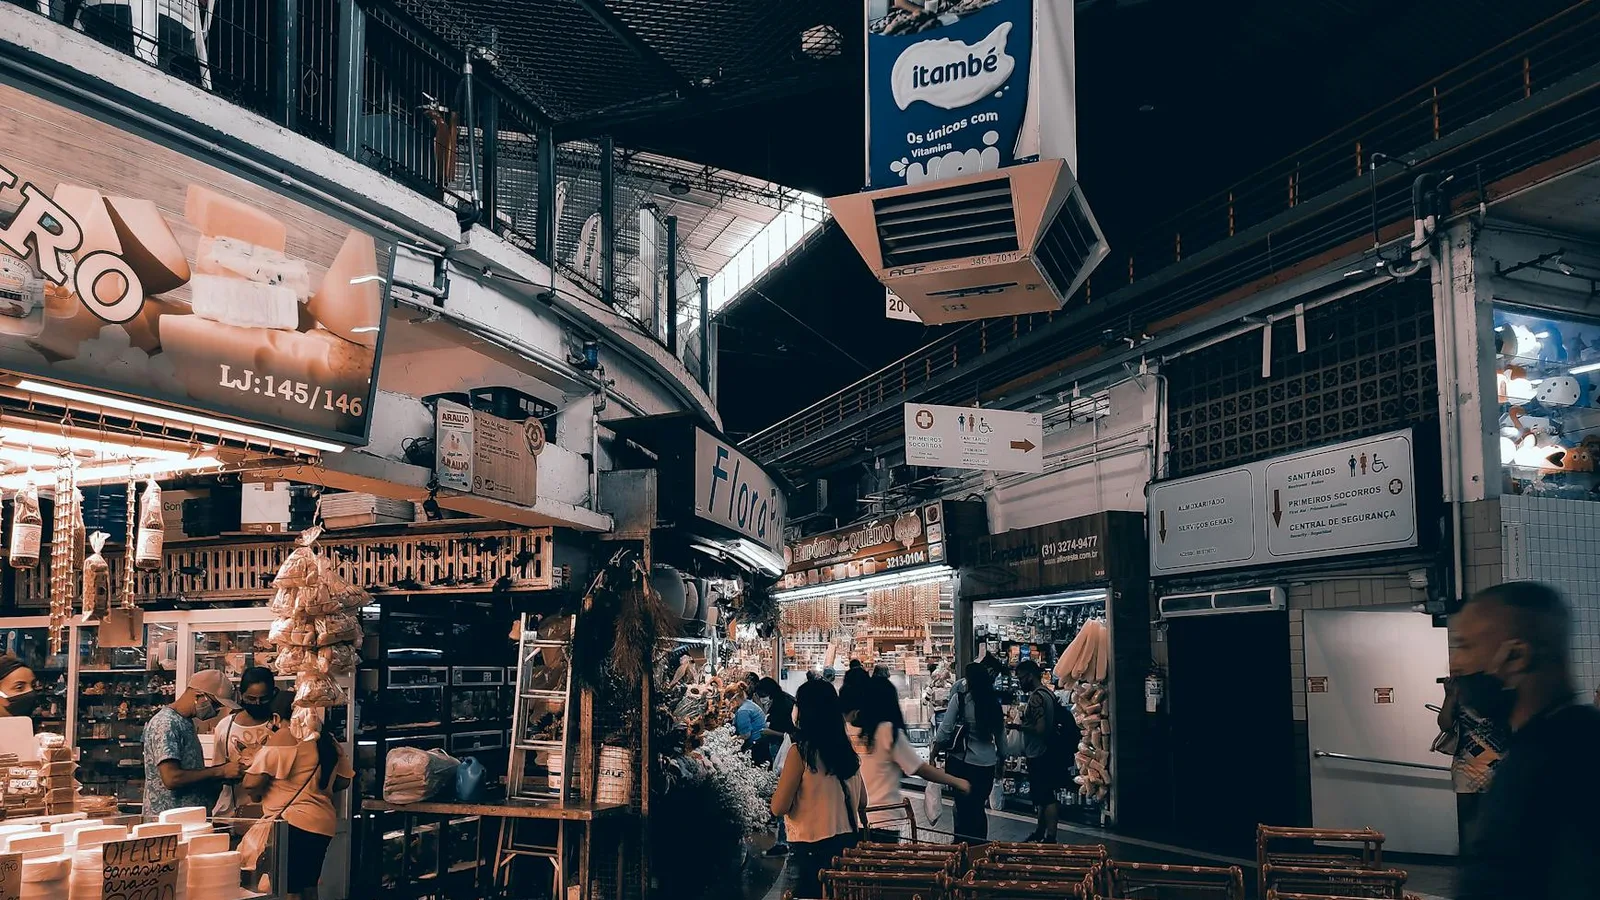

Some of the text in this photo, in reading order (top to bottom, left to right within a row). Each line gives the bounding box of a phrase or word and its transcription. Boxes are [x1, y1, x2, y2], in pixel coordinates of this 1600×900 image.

[912, 47, 998, 89] itambé
[907, 111, 999, 144] Os únicos com
[911, 142, 953, 158] Vitamina
[889, 265, 926, 277] ACF
[970, 252, 1018, 266] 3461-7011
[888, 298, 914, 314] 20
[219, 363, 363, 417] LJ:145/146
[442, 412, 470, 424] ARAUJO
[908, 435, 942, 443] PRIMEIROS
[441, 456, 469, 471] ARAUJO
[1287, 466, 1336, 482] SANITÁRIOS
[708, 445, 767, 538] Flora
[1288, 485, 1382, 507] PRIMEIROS SOCORROS
[1178, 498, 1225, 511] ALMOXARIFADO
[1178, 516, 1234, 532] SERVIÇOS GERAIS
[1289, 509, 1397, 531] CENTRAL DE SEGURANÇA
[794, 537, 839, 564] EMPÓRIO
[849, 522, 893, 553] QUEIJO
[1041, 542, 1057, 557] (31)
[1057, 535, 1099, 553] 3274-9477
[885, 550, 925, 569] 3213-0104
